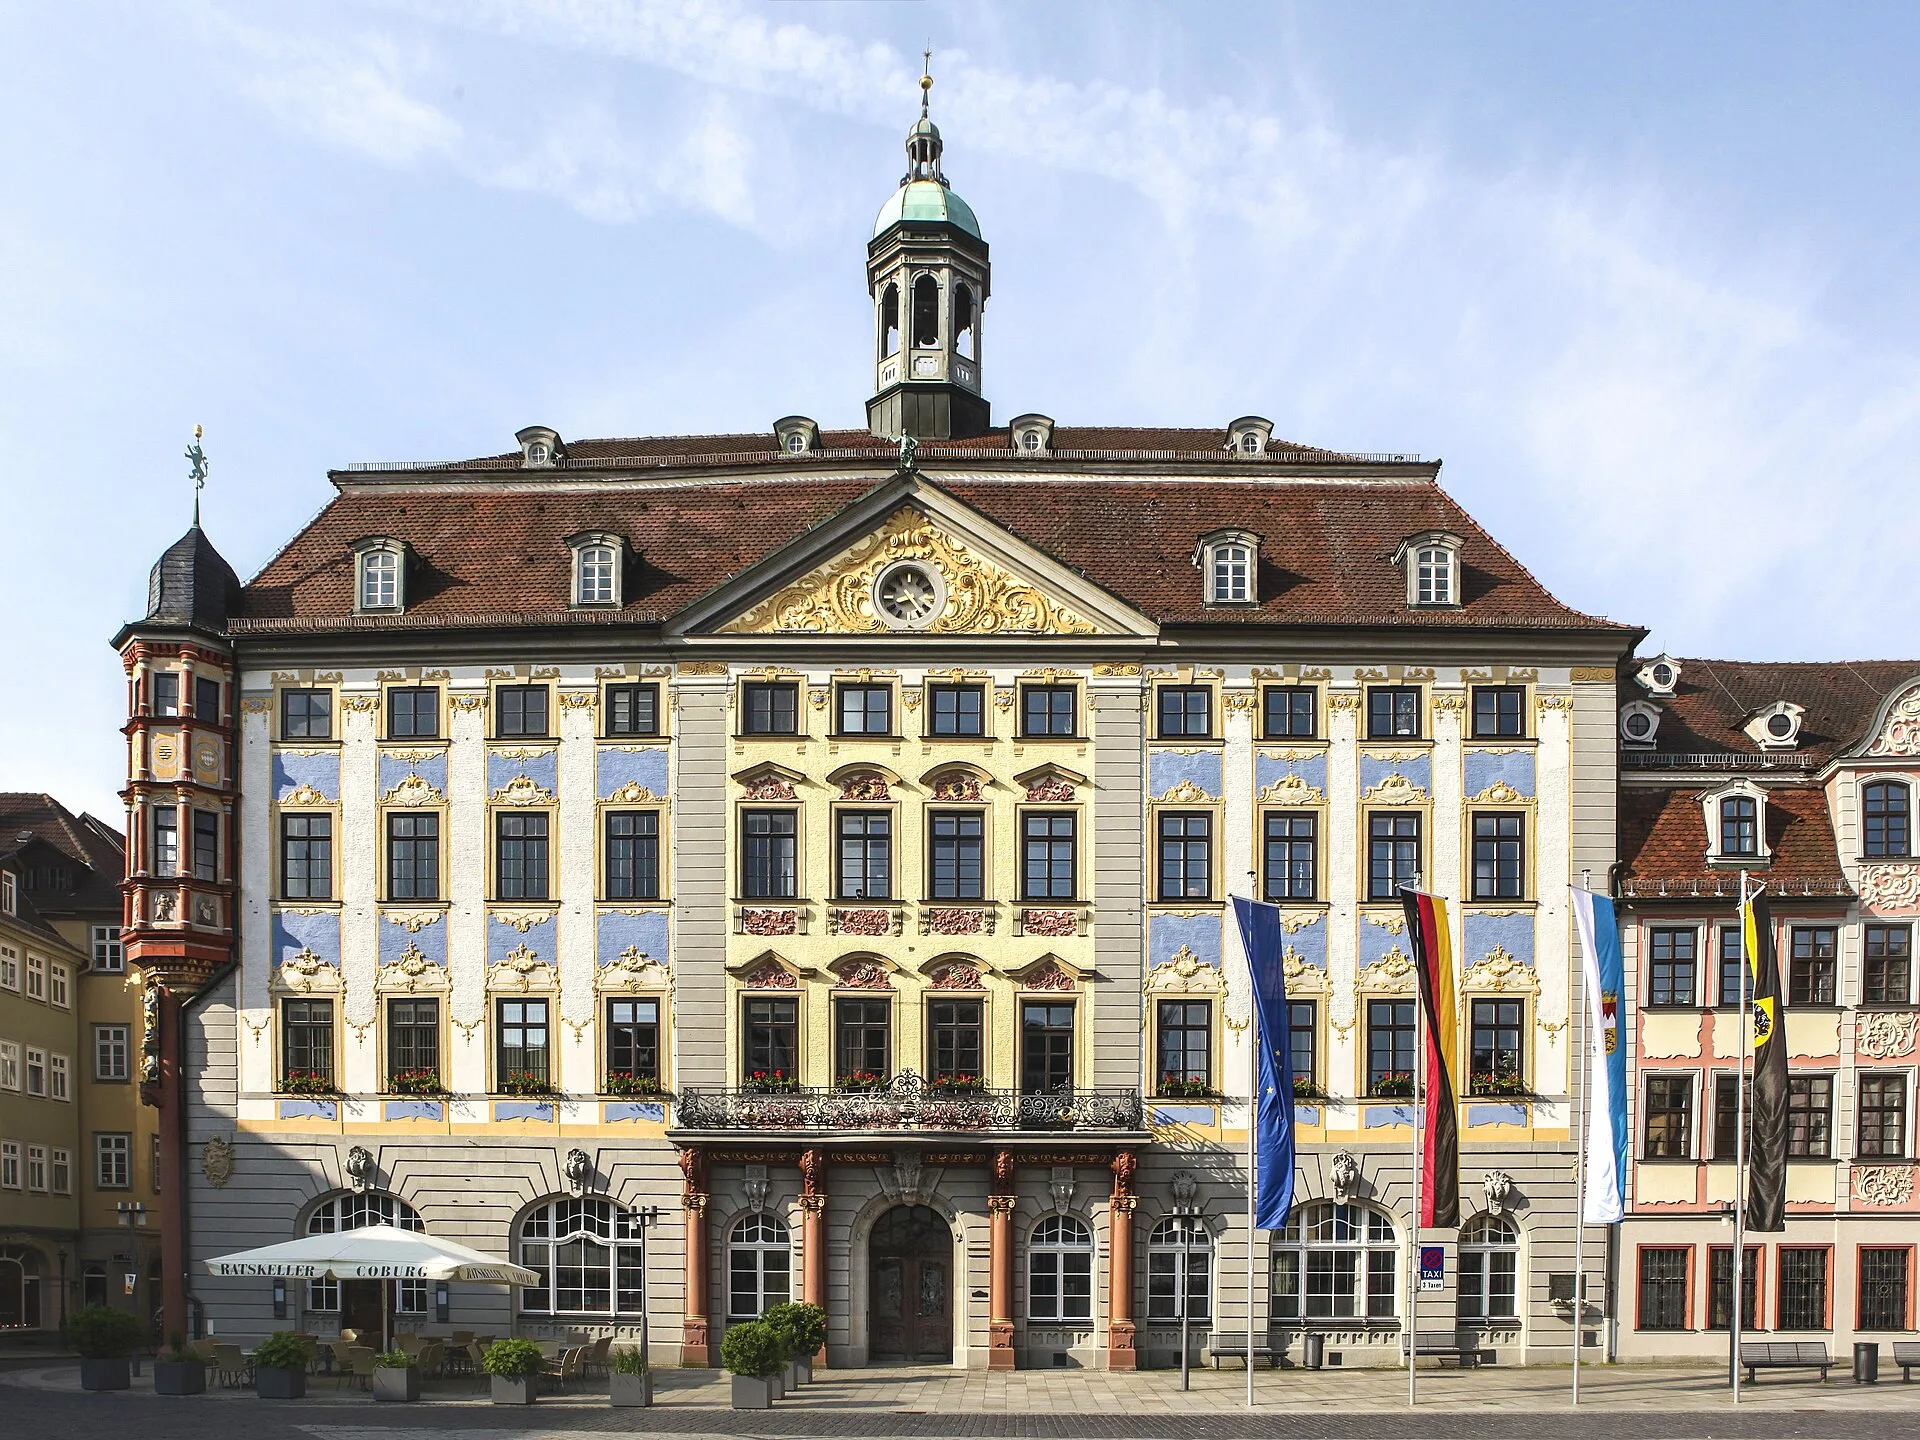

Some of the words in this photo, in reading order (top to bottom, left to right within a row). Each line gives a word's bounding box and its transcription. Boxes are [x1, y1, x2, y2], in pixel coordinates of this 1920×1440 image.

[220, 1263, 315, 1276] RATSKELLER
[356, 1265, 428, 1278] COBURG
[1422, 1270, 1442, 1278] TAXI
